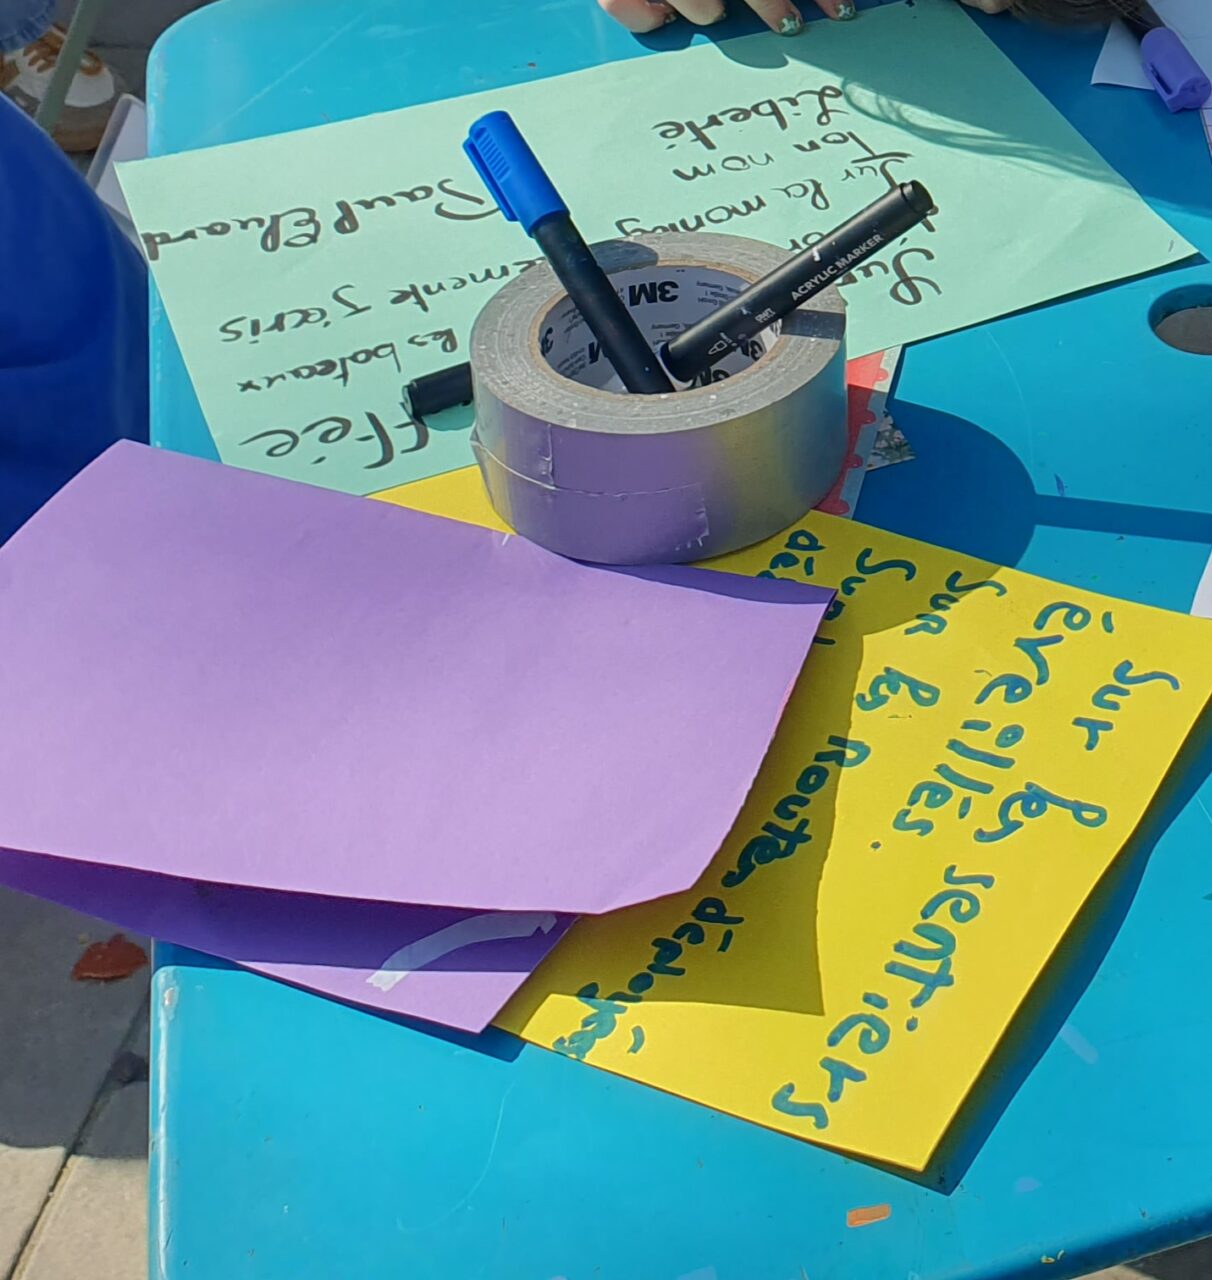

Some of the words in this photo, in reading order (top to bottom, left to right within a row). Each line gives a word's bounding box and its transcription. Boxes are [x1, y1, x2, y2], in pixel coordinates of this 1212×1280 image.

[650, 83, 849, 152] Liberté
[671, 150, 775, 183] nom
[793, 130, 914, 164] Ton
[771, 179, 831, 210] la
[790, 263, 838, 302] ACRYLIC
[837, 232, 885, 270] MARKER
[628, 280, 679, 307] 3M
[237, 342, 402, 394] bateaux
[1071, 660, 1181, 751] Sur
[771, 864, 996, 1130] sentiers
